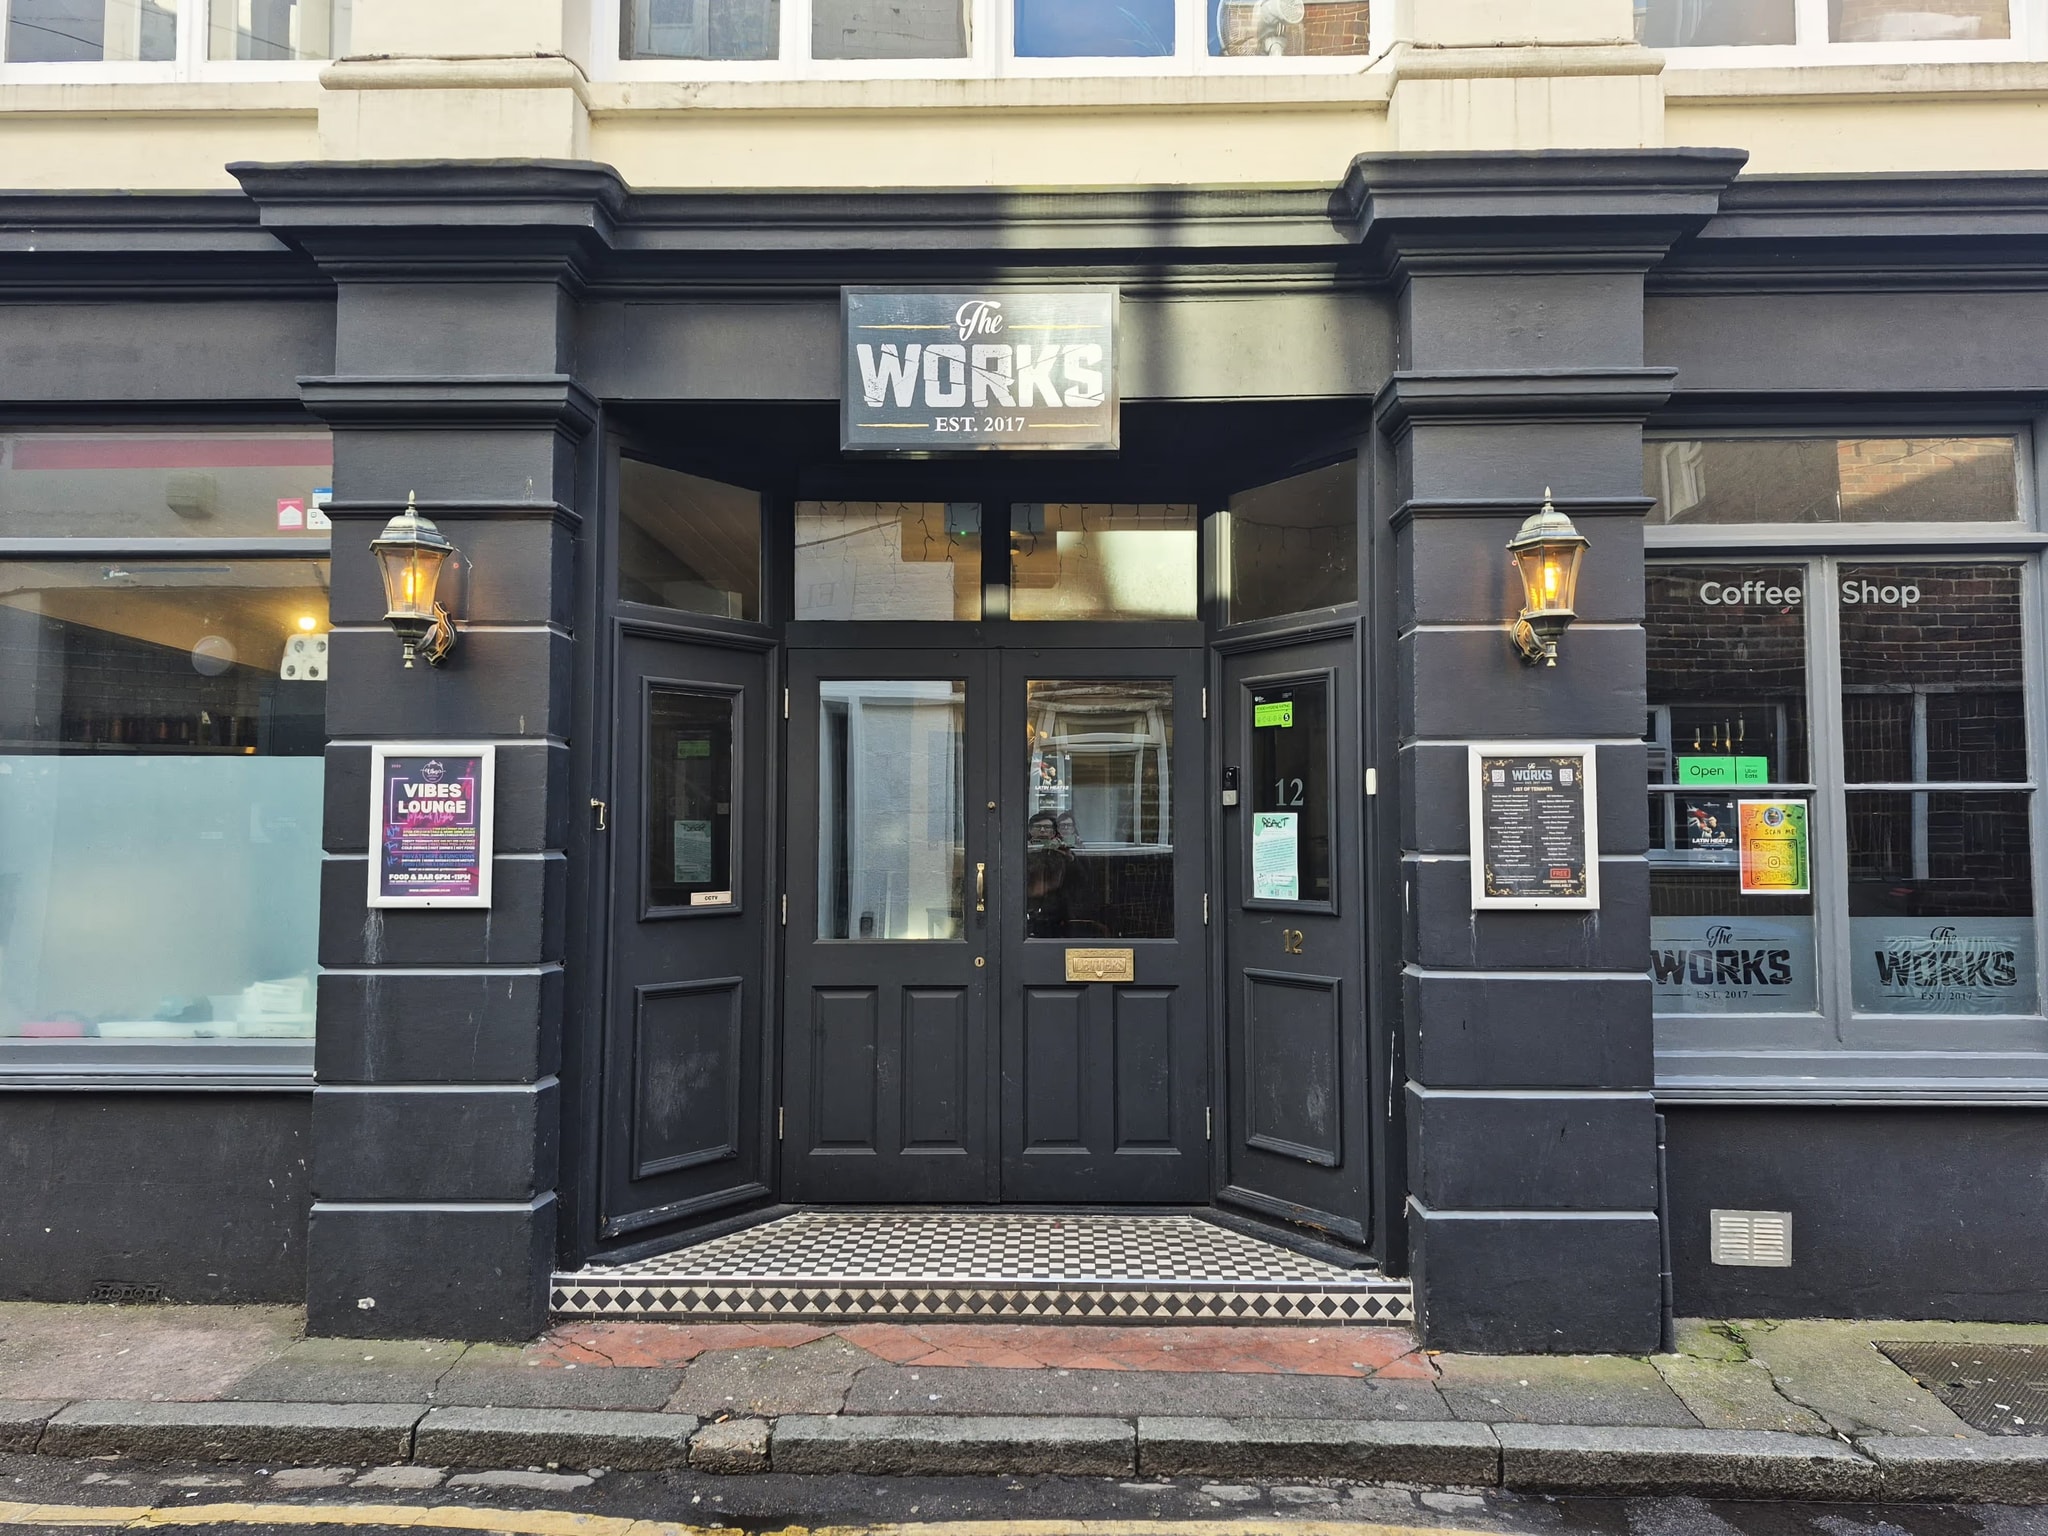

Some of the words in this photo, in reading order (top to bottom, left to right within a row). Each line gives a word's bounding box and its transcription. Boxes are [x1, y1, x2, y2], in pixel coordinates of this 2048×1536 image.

[955, 300, 1003, 341] The
[856, 343, 1105, 408] WORKS
[934, 416, 978, 432] EST.
[984, 416, 1025, 432] 2017
[1699, 581, 1802, 605] Coffee
[1841, 580, 1921, 608] Shop
[1512, 769, 1552, 781] WORKS
[1690, 765, 1724, 778] Open
[403, 783, 462, 798] VIBES
[1275, 778, 1304, 806] 12
[398, 800, 466, 814] LOUNGE
[1262, 817, 1290, 829] REACT
[1282, 929, 1303, 954] 12
[1706, 925, 1733, 948] The
[1930, 926, 1957, 948] The
[1651, 950, 1793, 985] WORKS
[1875, 951, 2017, 986] WORKS
[1696, 991, 1721, 999] EST.
[1725, 991, 1748, 999] 2017
[1921, 992, 1946, 1000] EST.
[1950, 992, 1973, 1000] 2017
